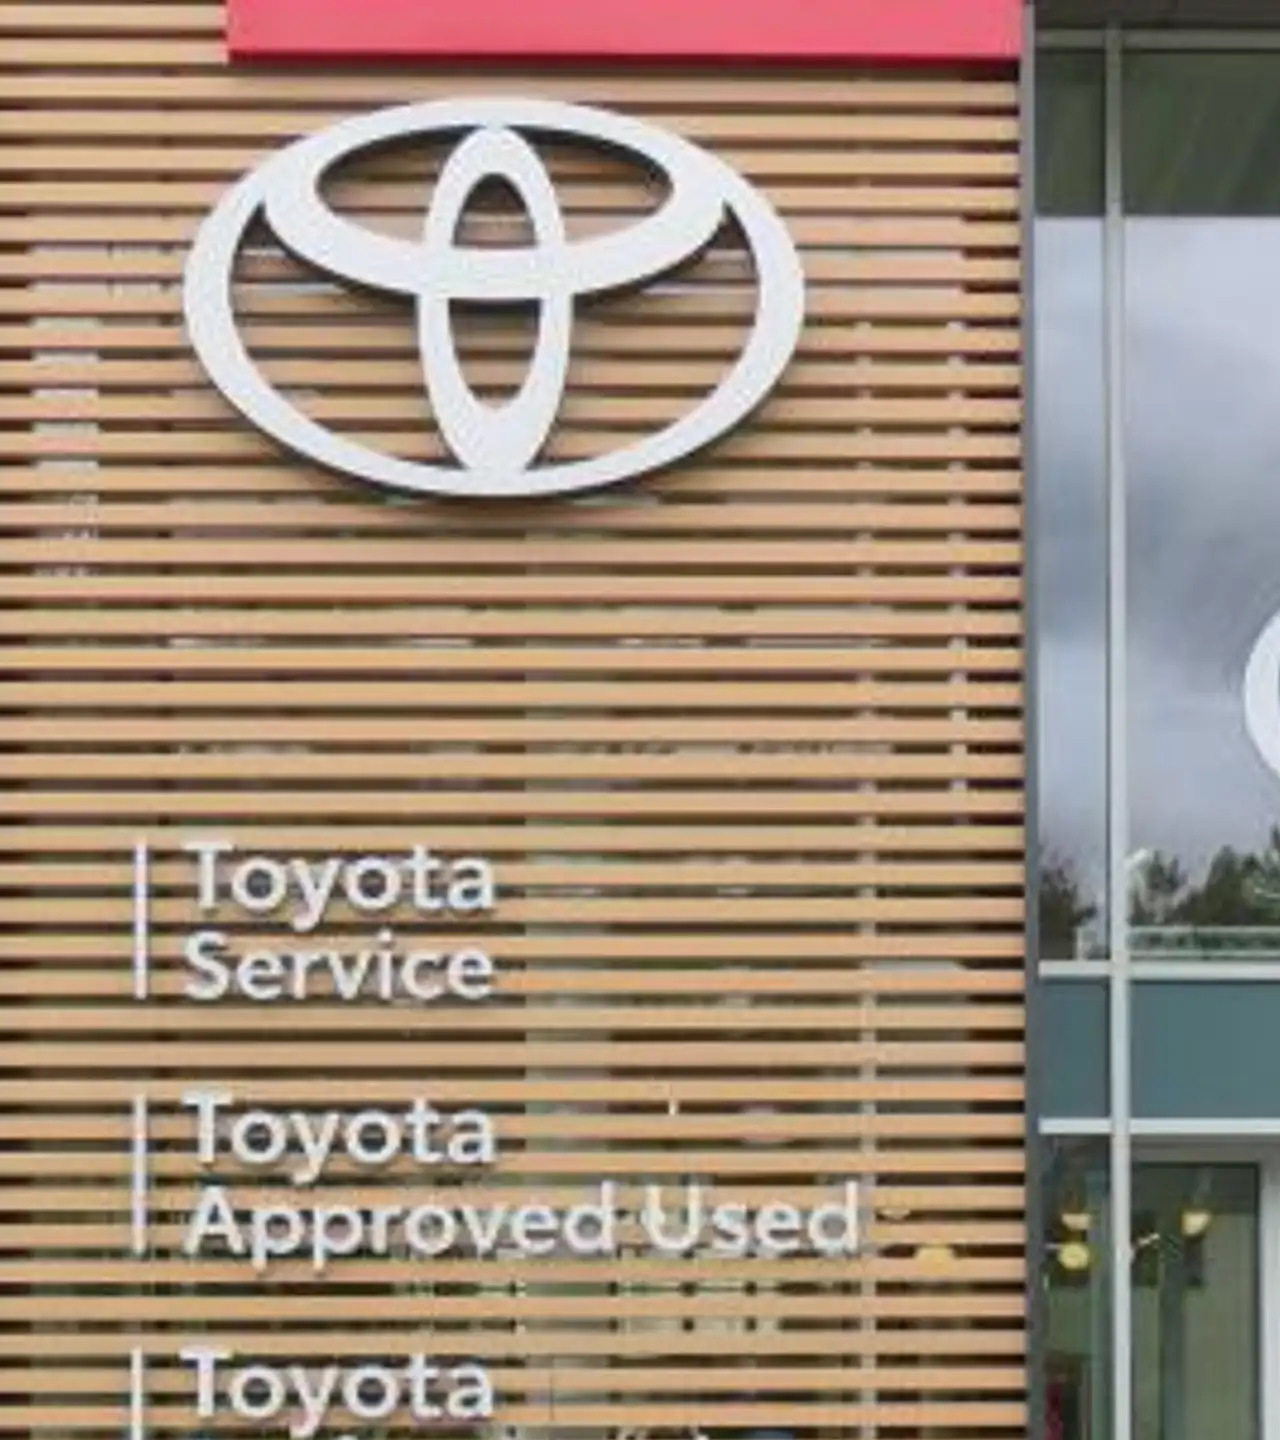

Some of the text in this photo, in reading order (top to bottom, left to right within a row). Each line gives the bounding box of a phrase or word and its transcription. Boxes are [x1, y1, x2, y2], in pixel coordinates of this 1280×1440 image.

[182, 840, 496, 931] Toyota
[183, 931, 496, 1000] Service
[182, 1092, 496, 1183] Toyota
[184, 1181, 860, 1276] Approved Used
[179, 1348, 495, 1438] Toyota
